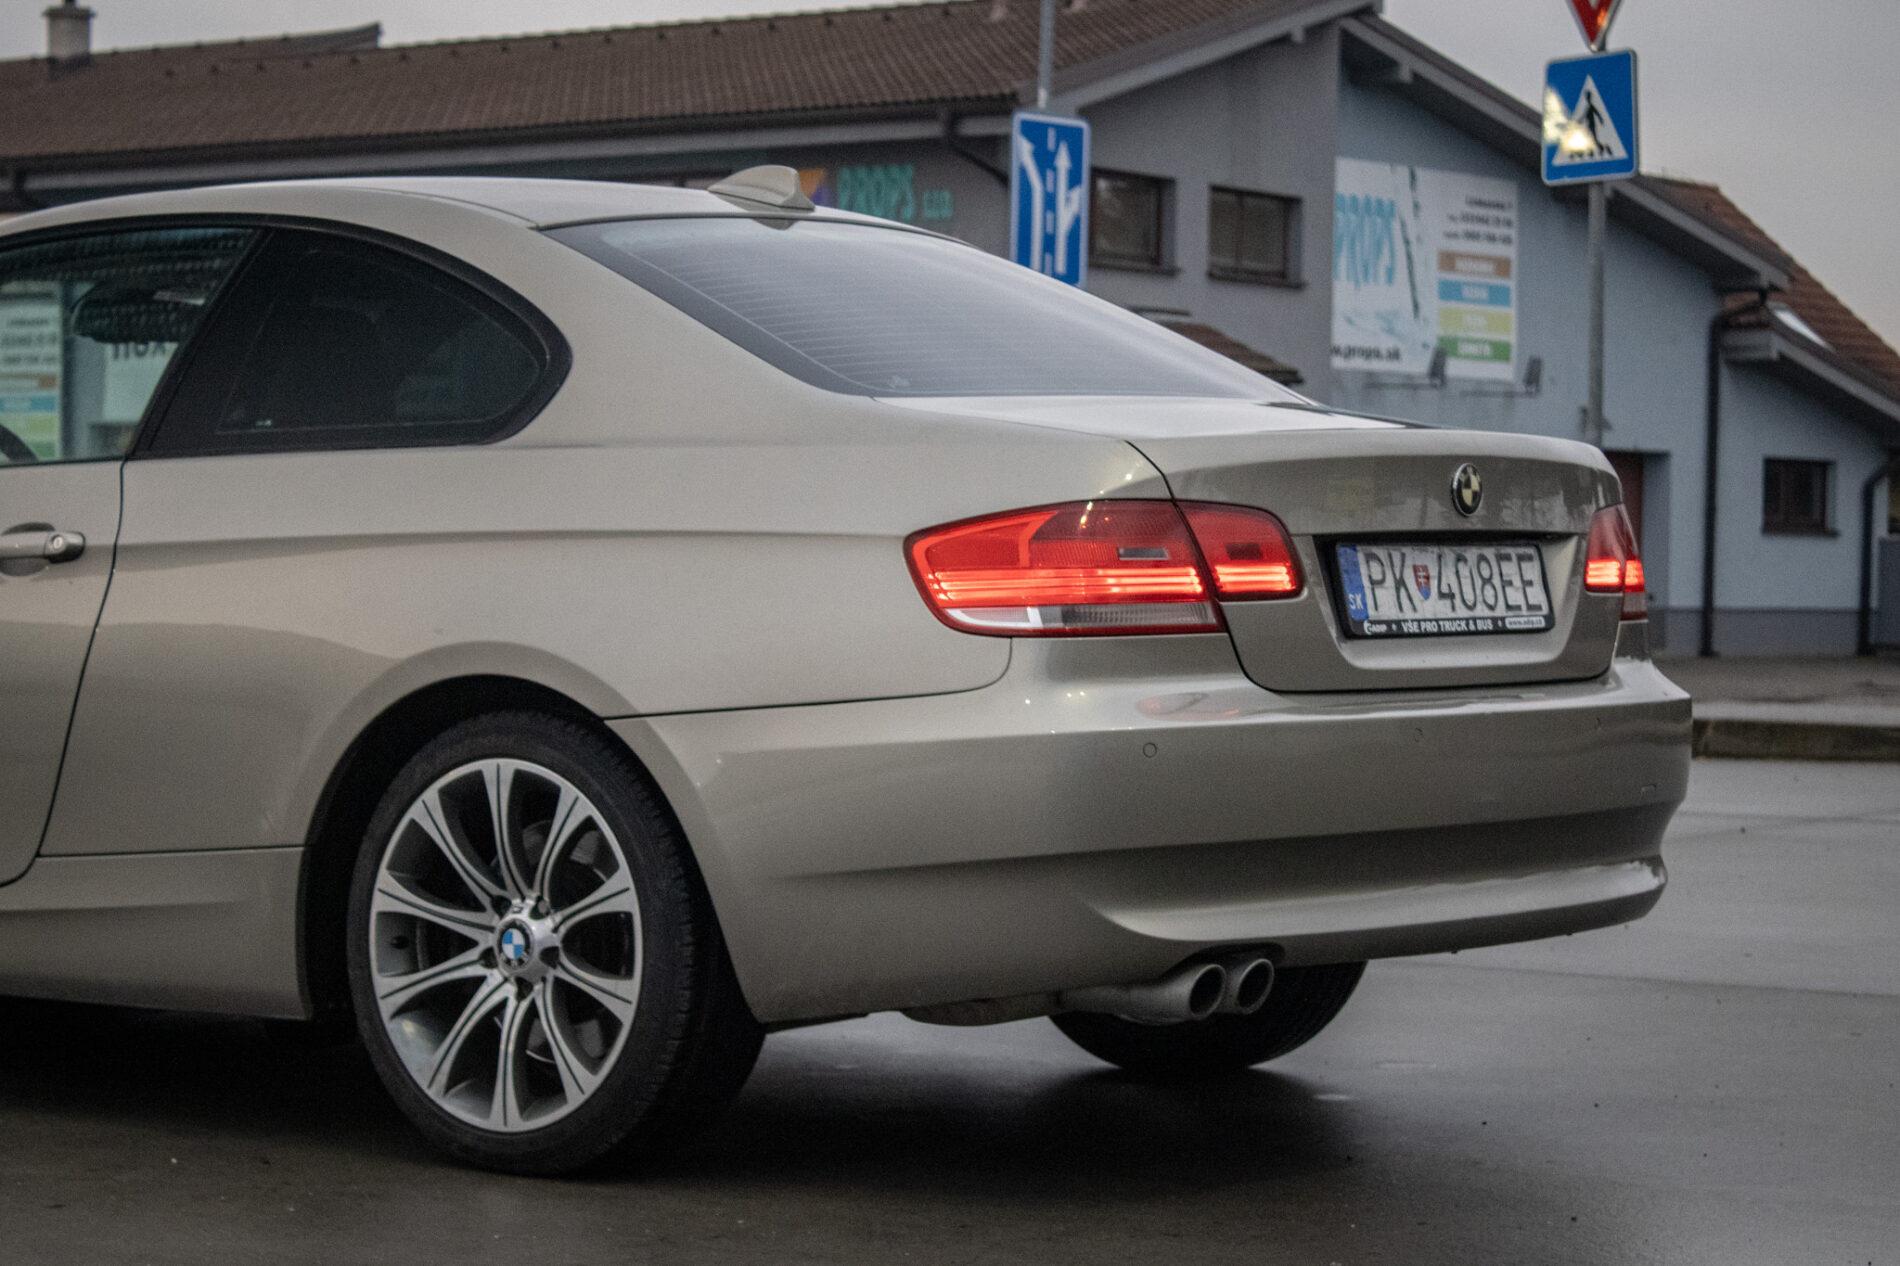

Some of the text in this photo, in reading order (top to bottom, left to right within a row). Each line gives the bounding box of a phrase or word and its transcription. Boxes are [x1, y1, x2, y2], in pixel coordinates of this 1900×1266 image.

[1349, 593, 1364, 610] SK
[1401, 619, 1420, 633] VŠE
[1420, 620, 1438, 632] PRO
[1440, 620, 1468, 632] TRUCK
[1476, 618, 1494, 630] BUS
